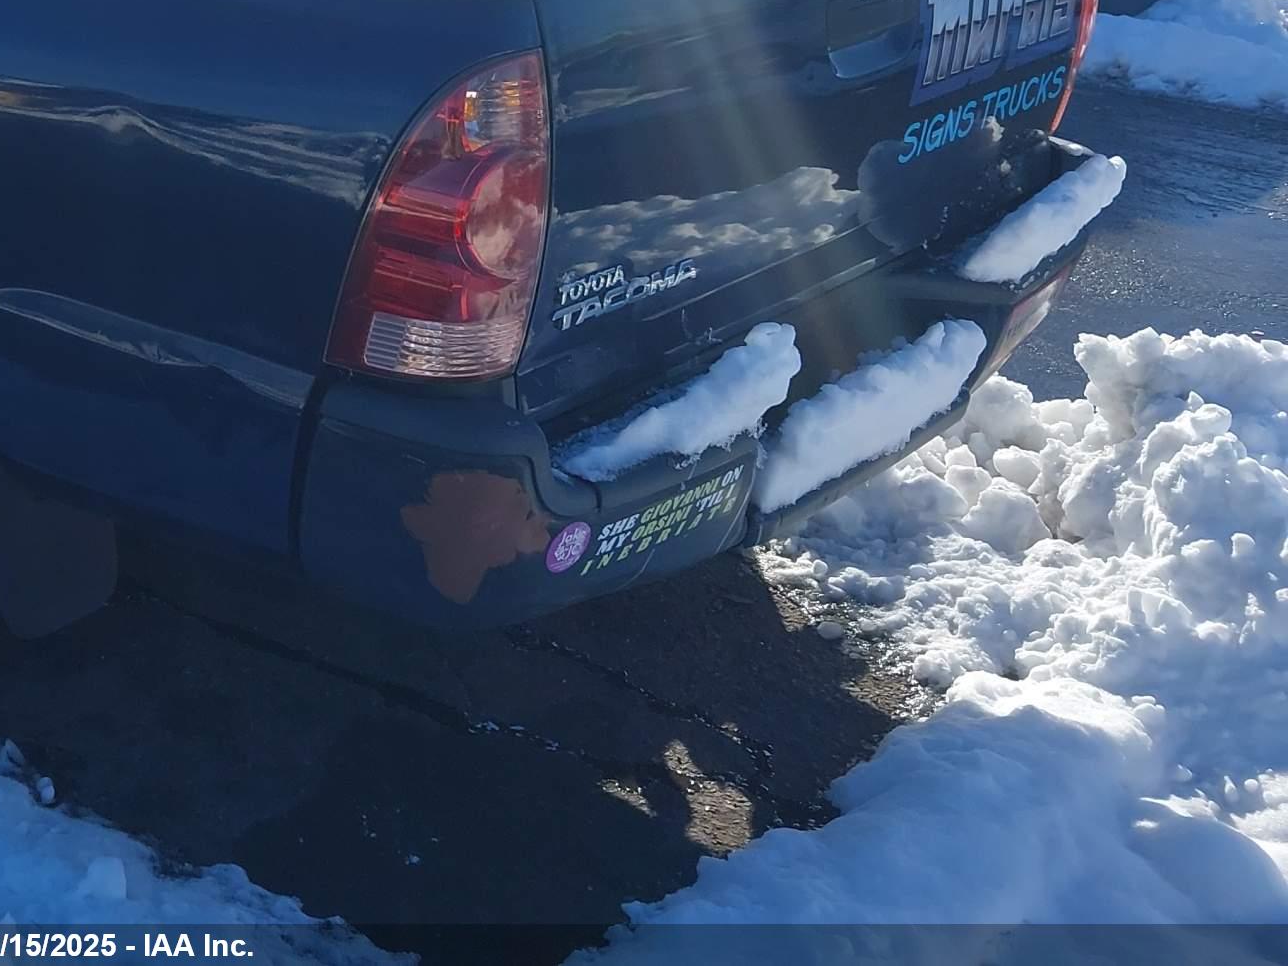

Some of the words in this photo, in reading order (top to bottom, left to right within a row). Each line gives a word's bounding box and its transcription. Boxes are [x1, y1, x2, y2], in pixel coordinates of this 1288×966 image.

[897, 100, 978, 164] SIGNS
[980, 66, 1067, 130] TRUCKS
[551, 258, 697, 331] TACOMA
[558, 264, 625, 306] TOYOTA
[595, 531, 632, 556] MY
[631, 504, 693, 542] ORSINI
[597, 513, 640, 541] SHE
[640, 477, 721, 524] GIOVANNI
[721, 465, 745, 486] ON
